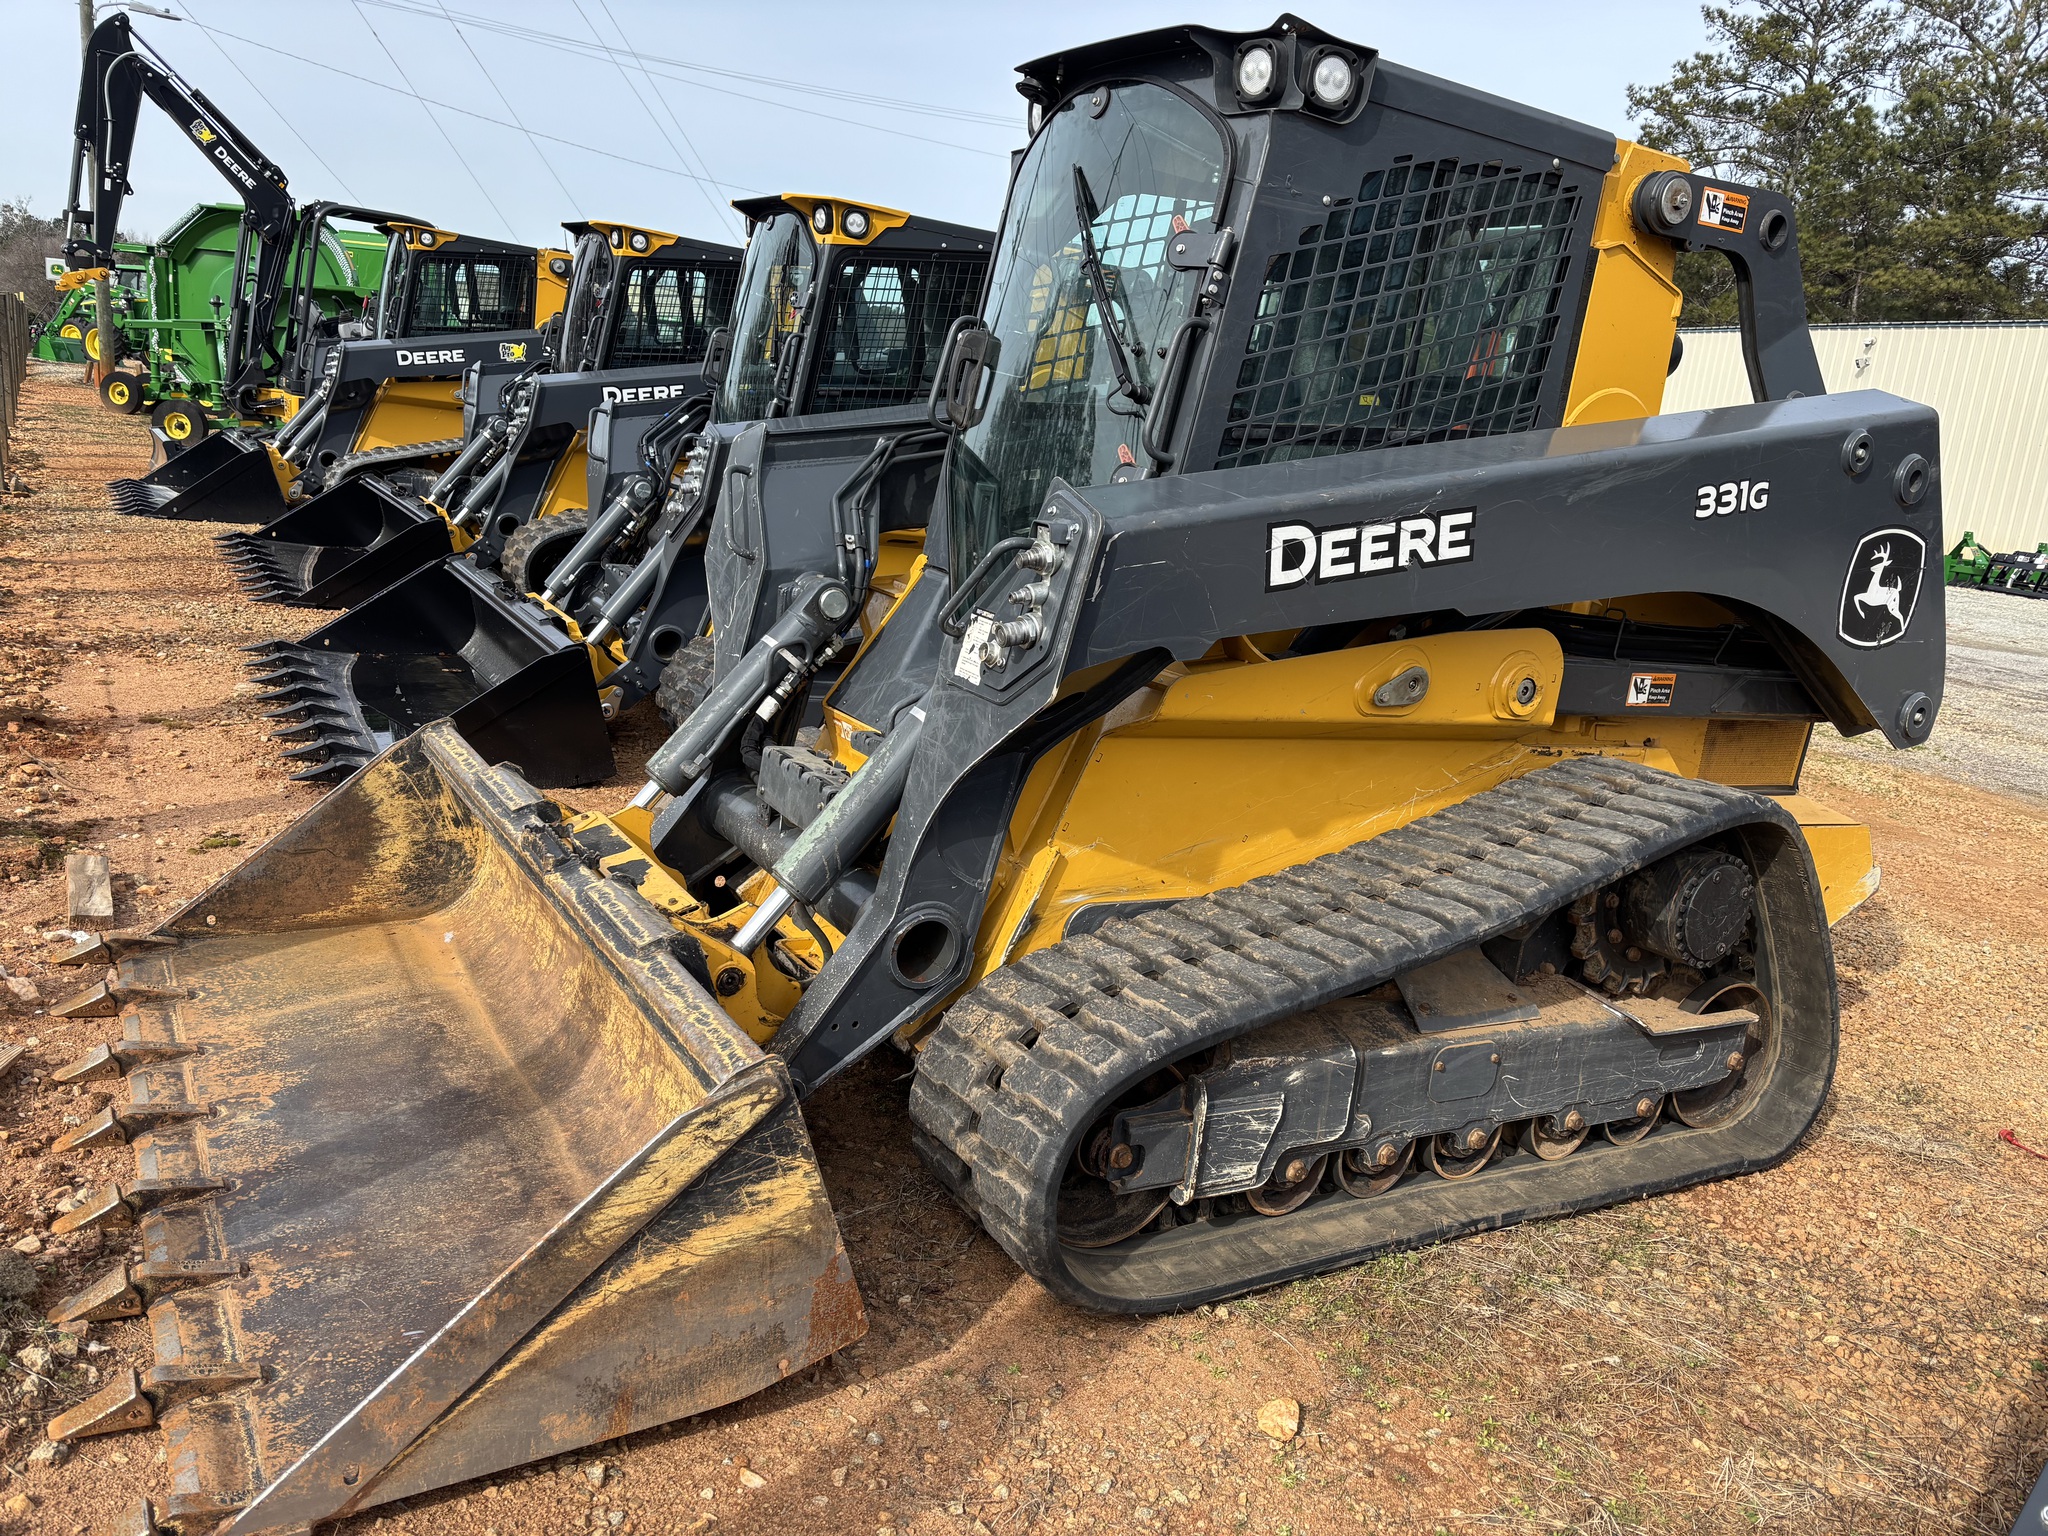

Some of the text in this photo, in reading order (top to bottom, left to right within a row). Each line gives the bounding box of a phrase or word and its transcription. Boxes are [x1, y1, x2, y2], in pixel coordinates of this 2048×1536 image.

[214, 145, 257, 190] DEERE
[1722, 207, 1744, 218] Pinch Area
[1730, 218, 1739, 226] Away
[396, 349, 466, 366] DEERE
[602, 384, 684, 404] DEERE
[1695, 480, 1770, 518] 331G
[1269, 511, 1473, 587] DEERE
